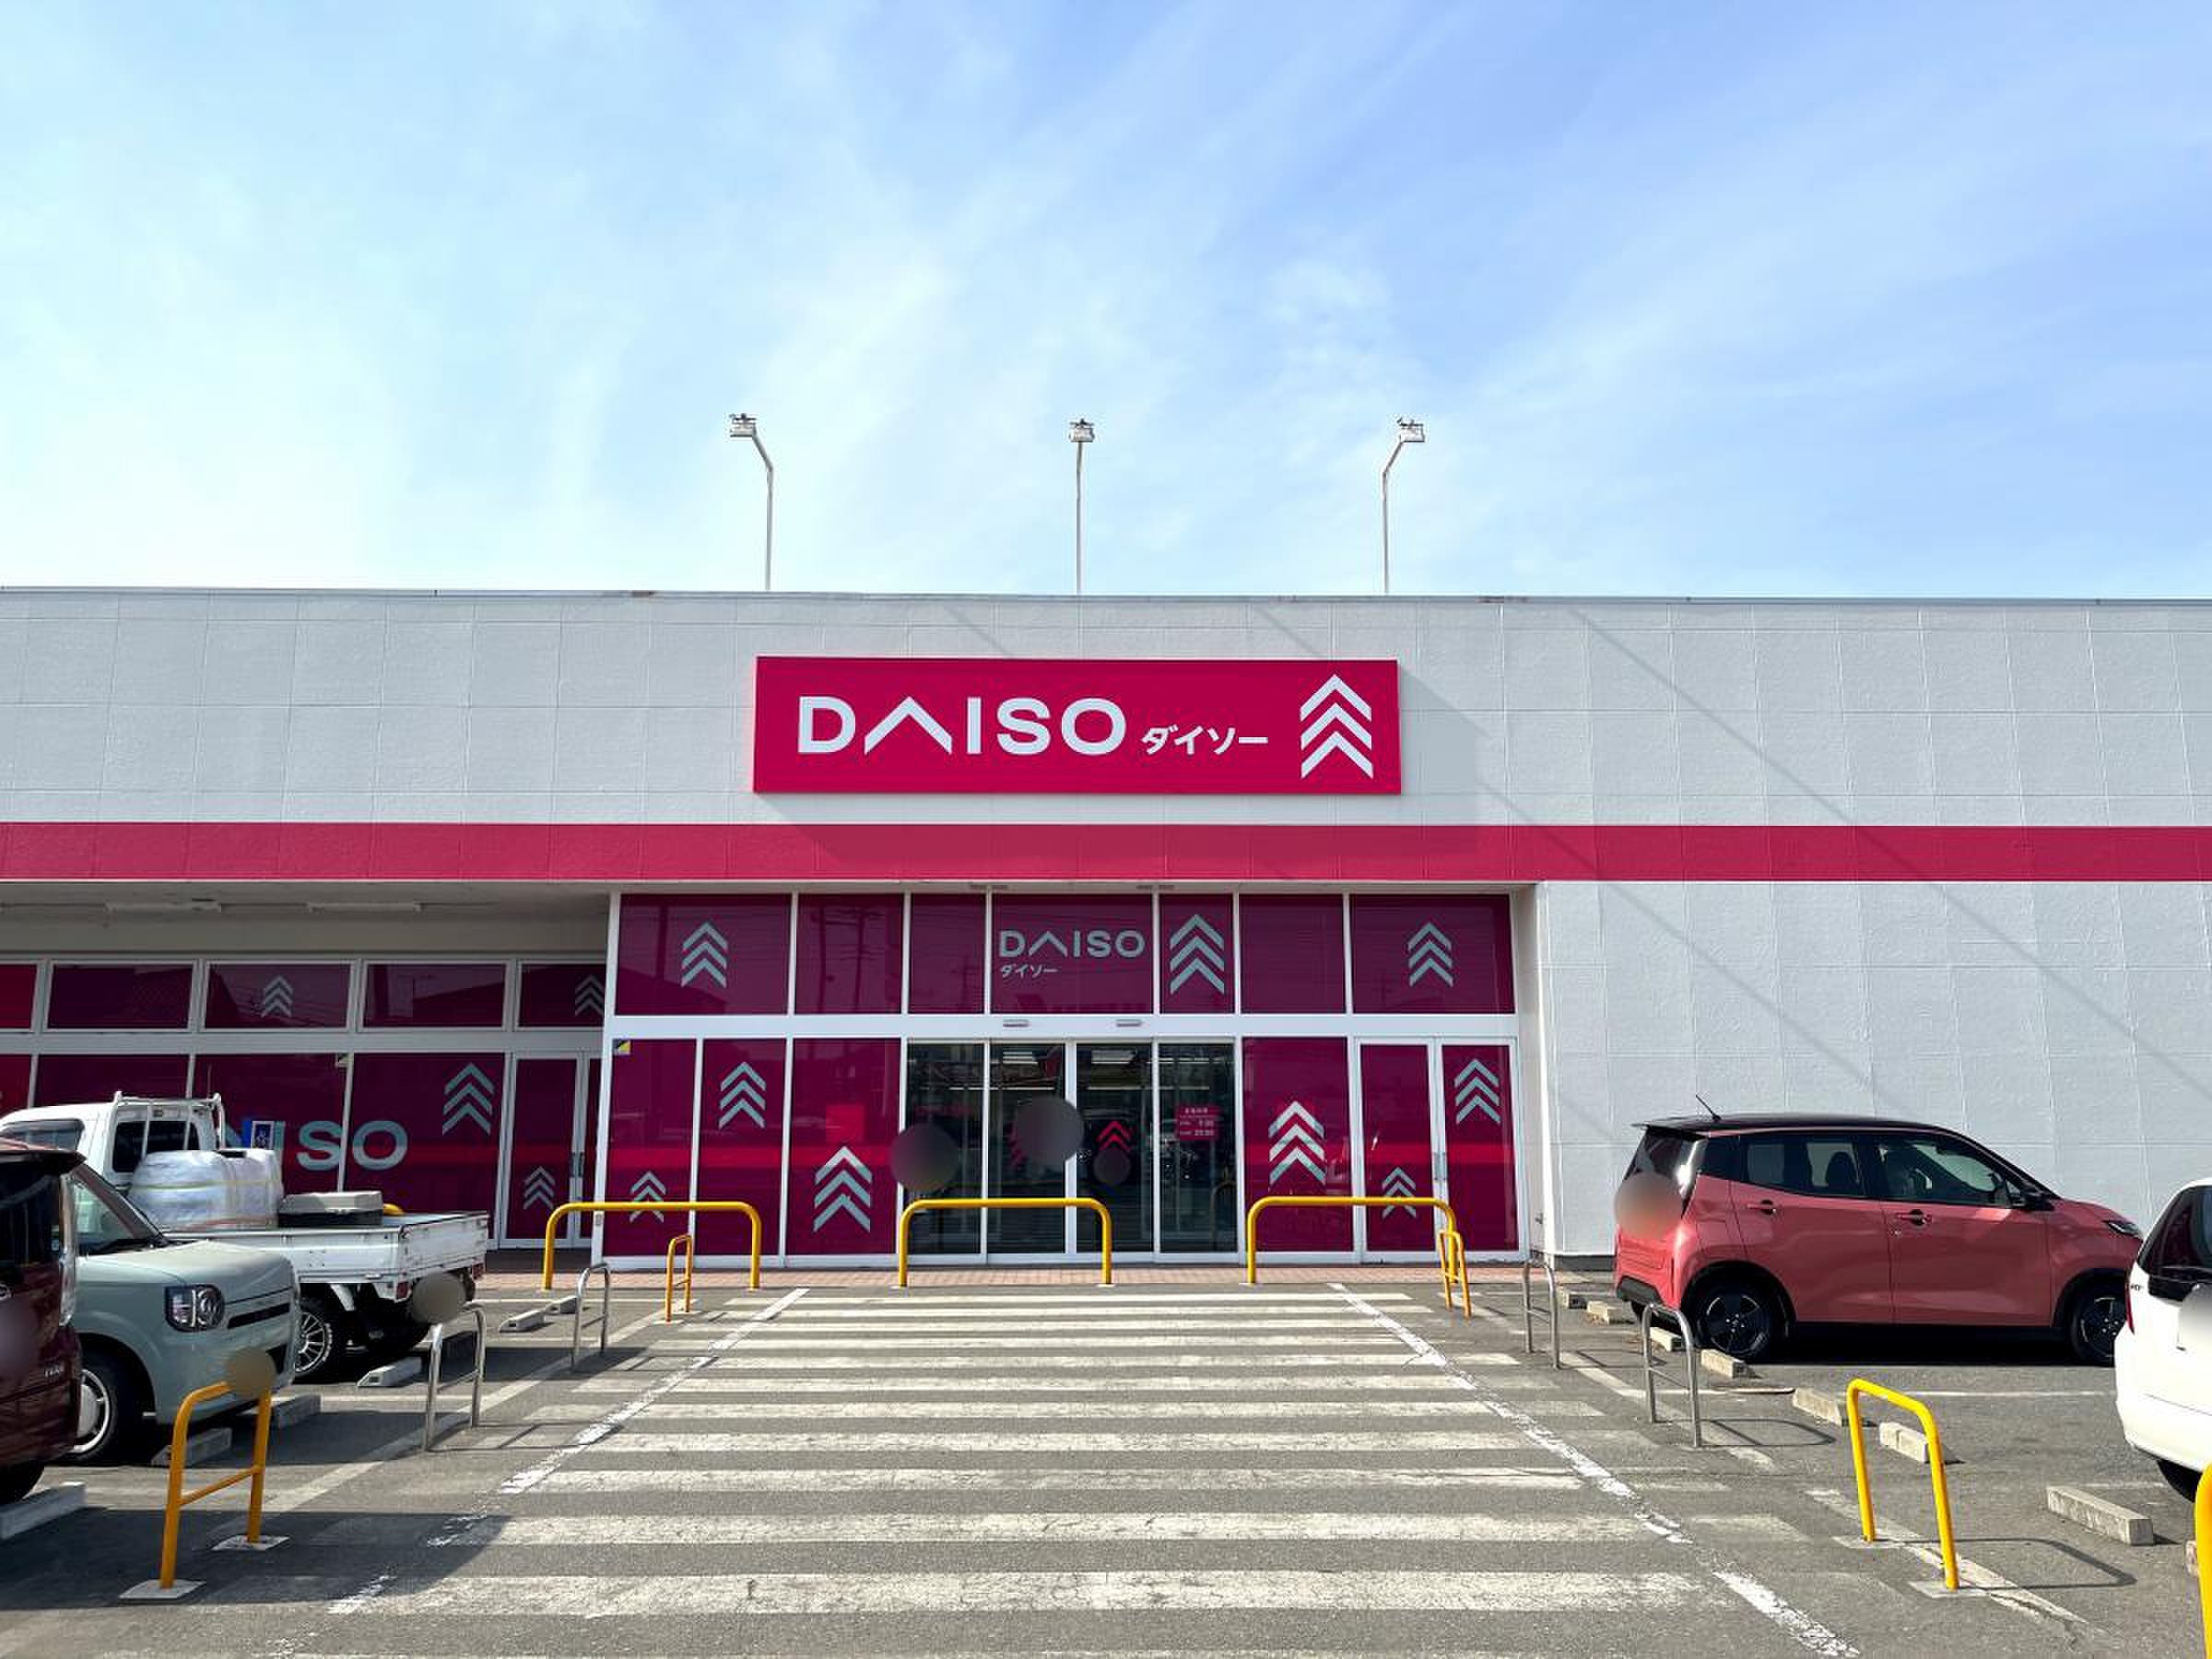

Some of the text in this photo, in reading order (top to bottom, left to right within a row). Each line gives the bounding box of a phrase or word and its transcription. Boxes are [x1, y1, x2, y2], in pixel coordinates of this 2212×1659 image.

[797, 696, 1126, 756] DAISO
[1141, 724, 1269, 755] ダイソー
[999, 930, 1146, 958] DAISO
[1000, 963, 1059, 979] ダイソー
[224, 1120, 408, 1171] ISO
